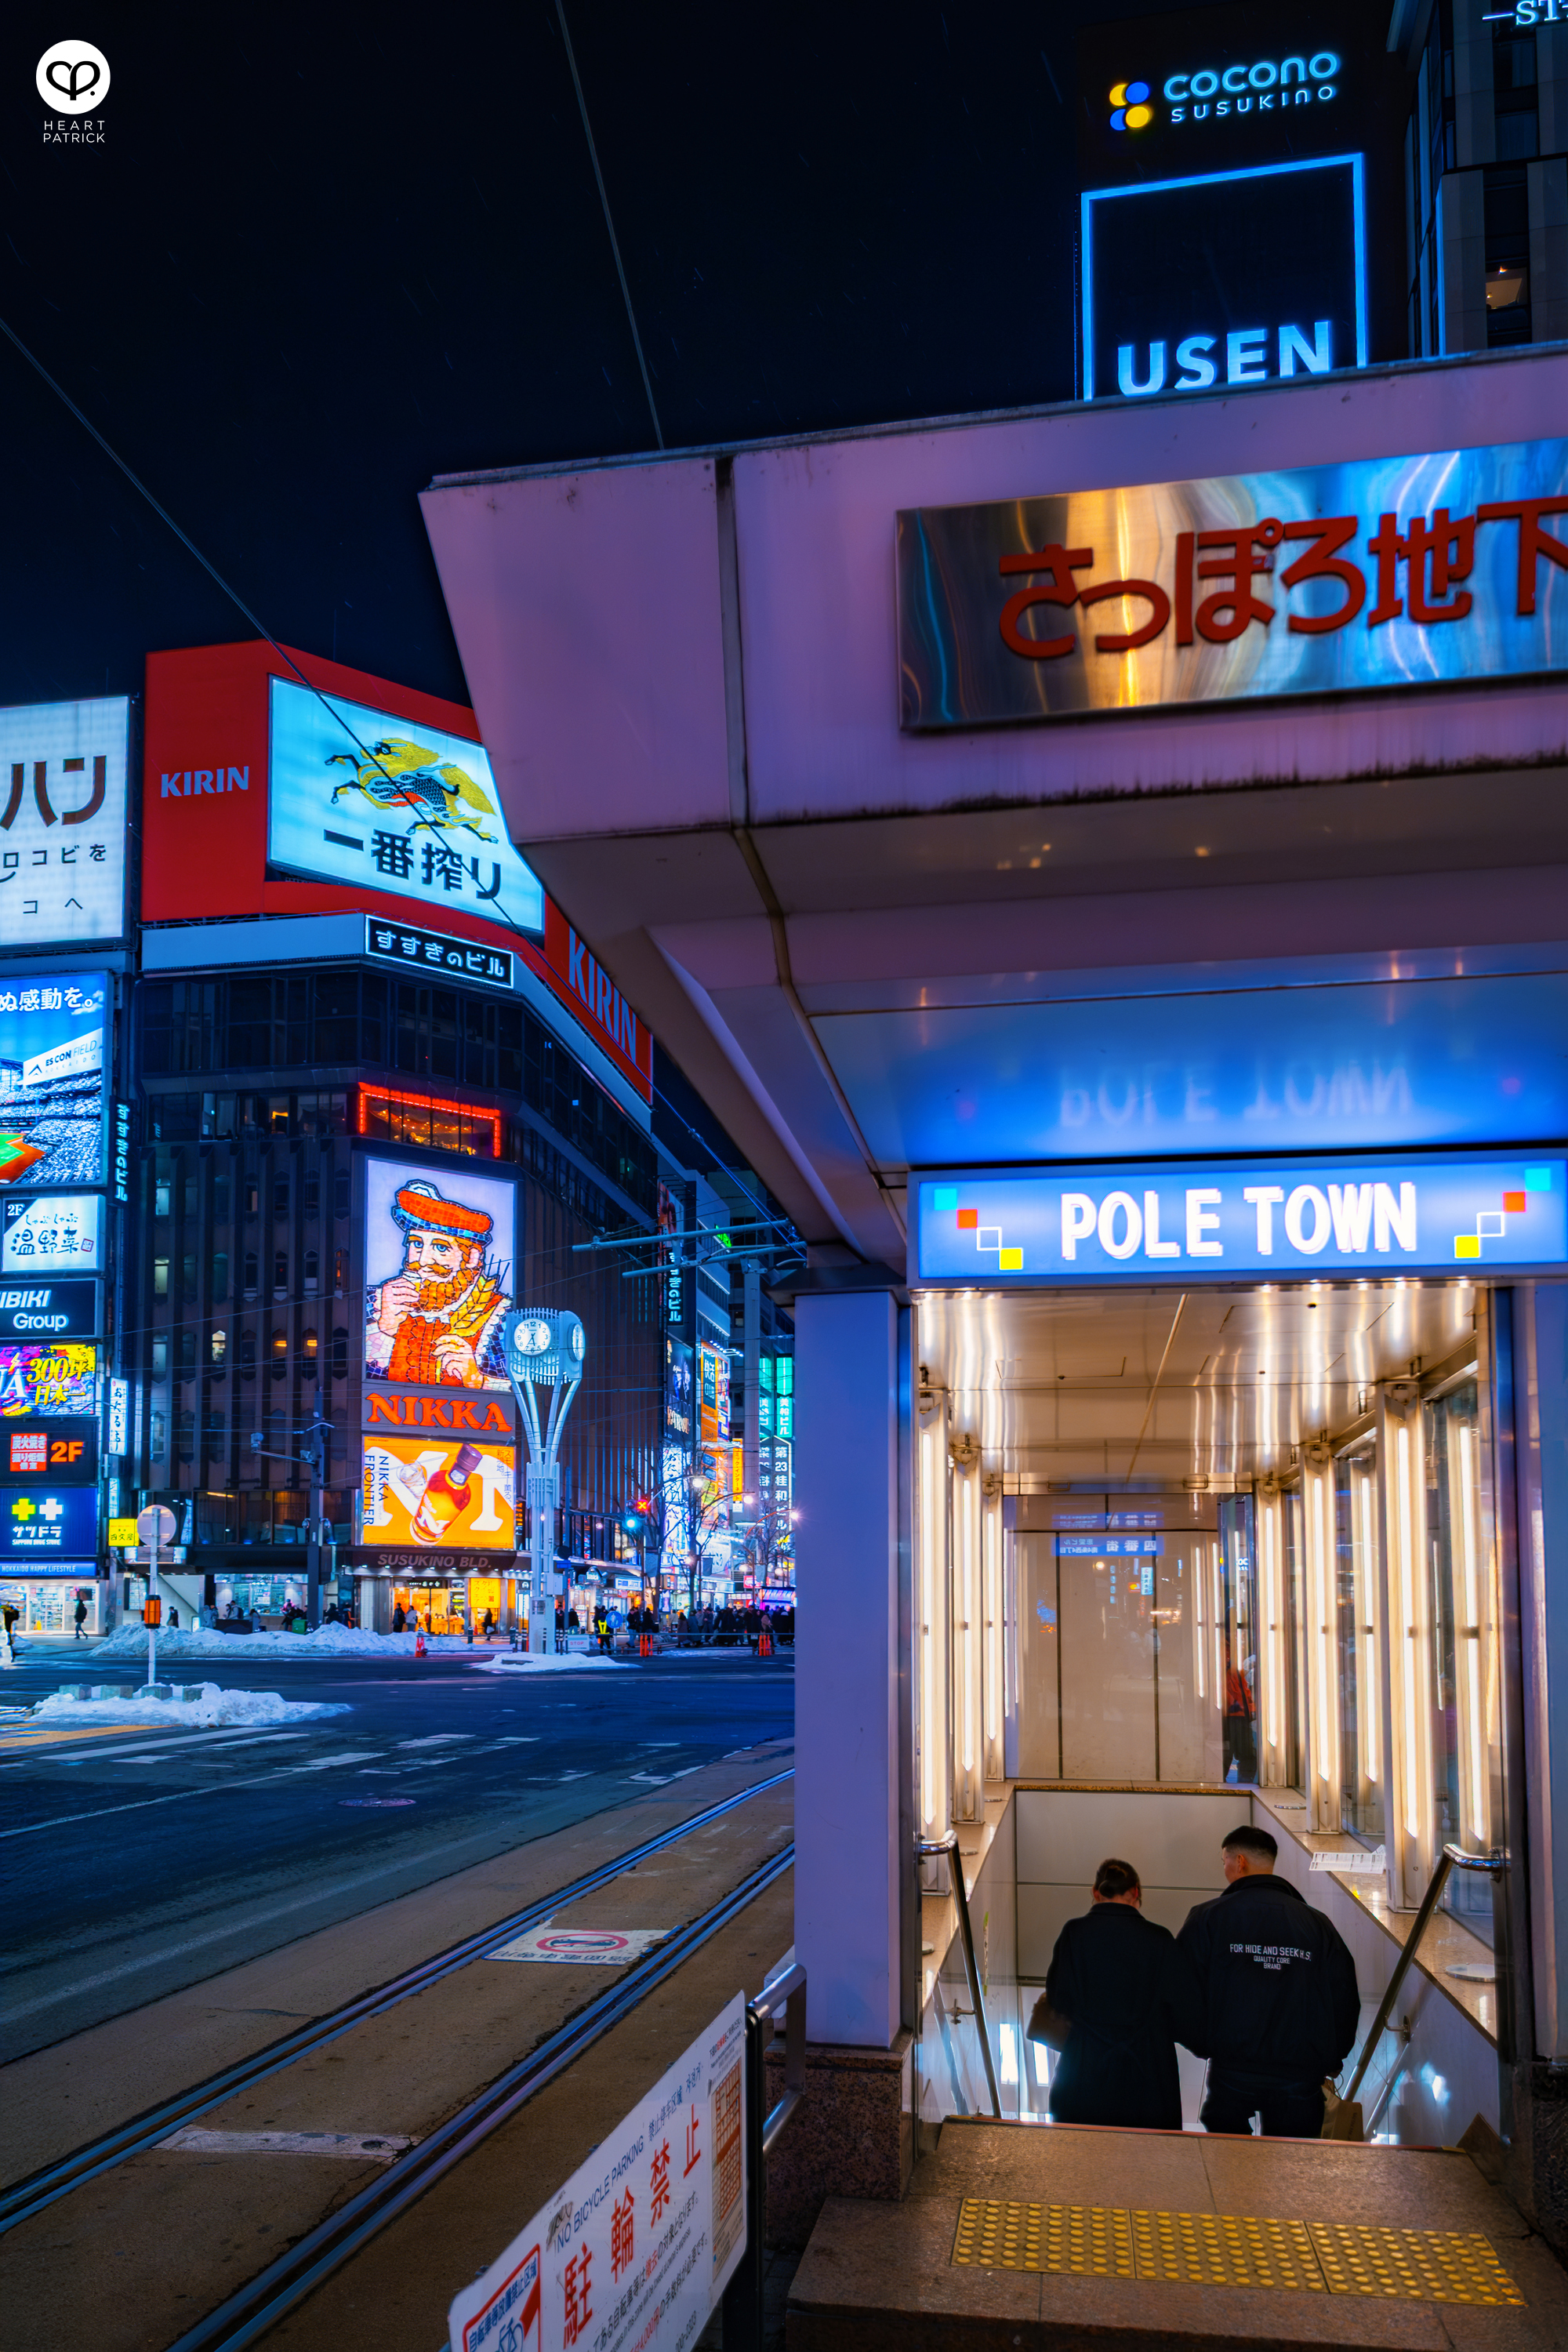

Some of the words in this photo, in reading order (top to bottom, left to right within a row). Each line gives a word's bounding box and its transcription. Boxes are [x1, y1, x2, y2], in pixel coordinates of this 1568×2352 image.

[1515, 0, 1568, 25] ST
[1117, 320, 1331, 397] USEN
[160, 766, 250, 798] KIRIN
[323, 829, 503, 900] 一番搾り
[375, 930, 506, 978] すすきのビル
[568, 926, 637, 1064] KIRIN
[45, 1058, 53, 1067] ES
[54, 1050, 72, 1064] CON
[73, 1040, 97, 1058] FIELD
[114, 1103, 131, 1202] すすきのビル
[7, 1203, 25, 1216] 2F
[26, 1213, 78, 1225] しゃぶしゃぶ
[1061, 1187, 1225, 1261] POLE
[1243, 1181, 1417, 1256] TOWN
[10, 1226, 80, 1255] 温野菜
[0, 1290, 52, 1308] IBIKI
[13, 1312, 69, 1331] Group
[27, 1358, 89, 1383] 300坪
[34, 1384, 86, 1406] 日本一
[365, 1392, 513, 1432] NIKKA
[50, 1441, 84, 1462] 2F
[363, 1455, 375, 1526] FRONTIER
[379, 1456, 389, 1502] NIKKA
[775, 1446, 788, 1531] 第23桂和ビル
[12, 1525, 62, 1538] サツドラ
[378, 1554, 455, 1567] SUSUKINO
[459, 1557, 492, 1568] BLD.
[1229, 1944, 1243, 1953] FOR
[1245, 1944, 1262, 1955] HIDE
[1262, 1946, 1278, 1955] AND
[1279, 1947, 1299, 1958] SEEK
[557, 2222, 572, 2254] NO
[574, 2174, 610, 2234] BICYCLE
[612, 2135, 644, 2187] PARKING
[562, 2103, 702, 2350] 駐輪禁止
